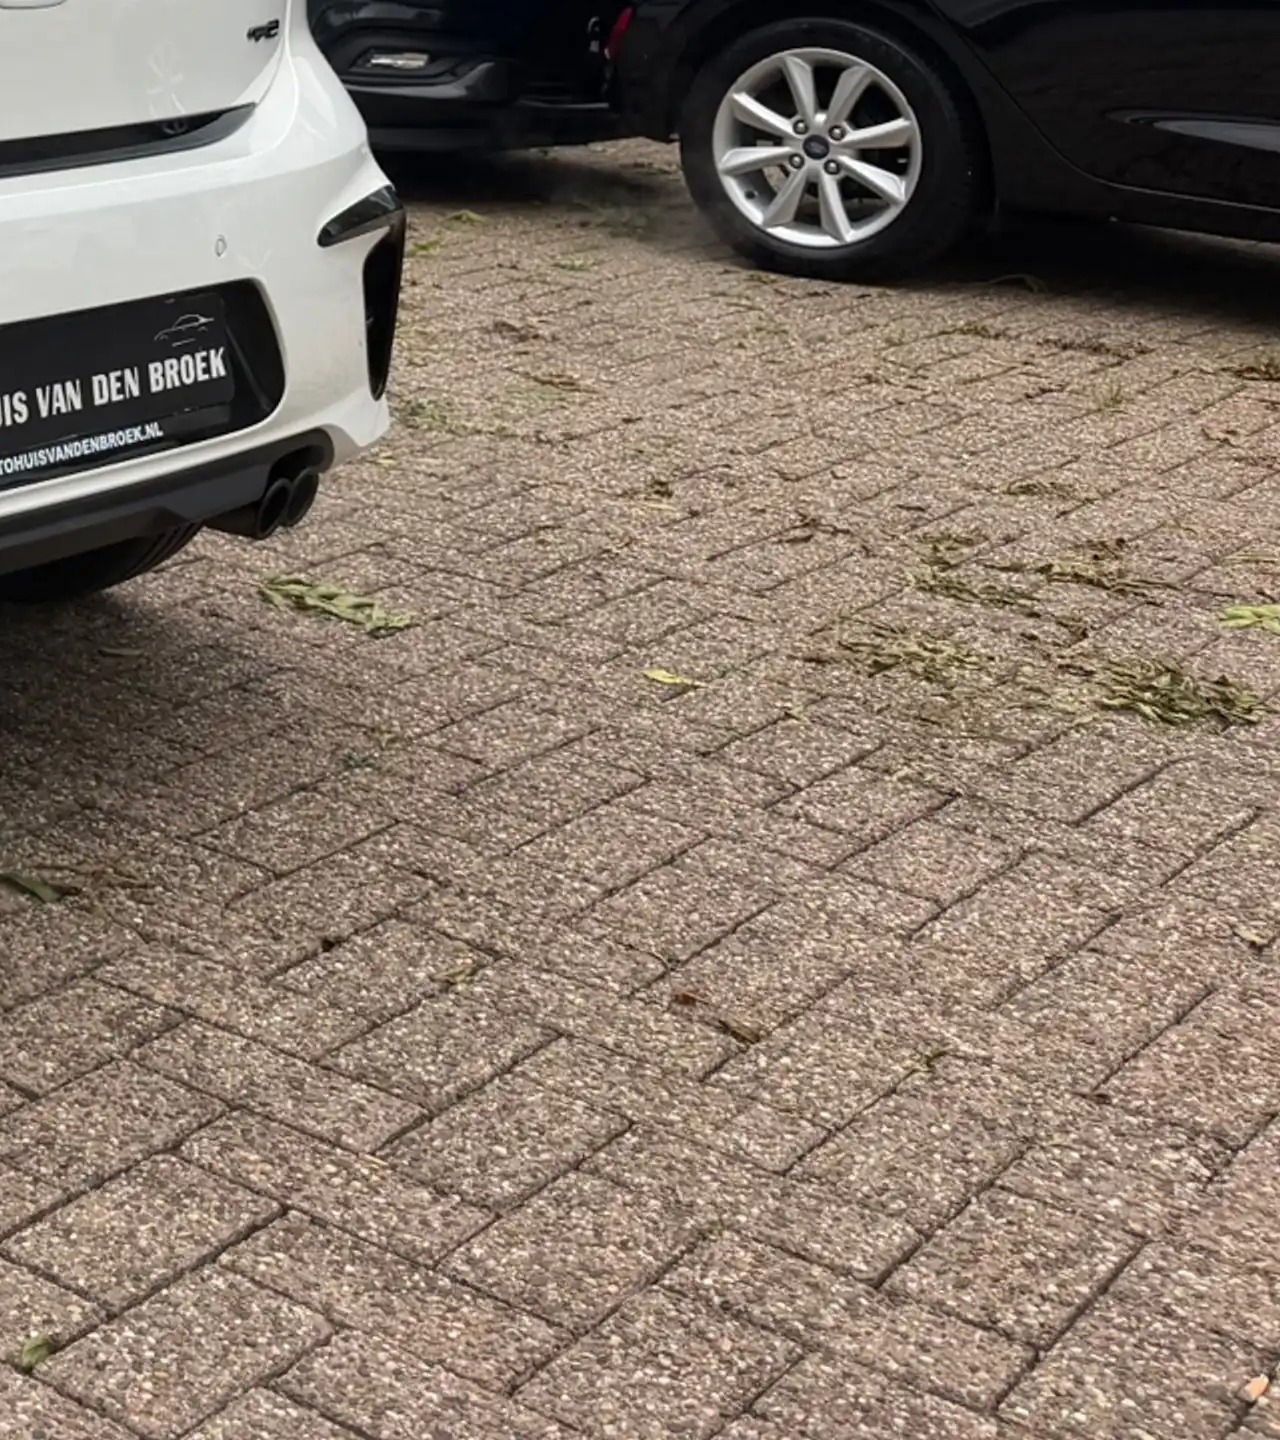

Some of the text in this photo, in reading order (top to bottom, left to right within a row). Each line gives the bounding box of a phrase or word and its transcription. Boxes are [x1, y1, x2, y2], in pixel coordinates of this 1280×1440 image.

[35, 378, 83, 418] VAN
[91, 366, 140, 406] DEN
[147, 346, 227, 394] BROEK
